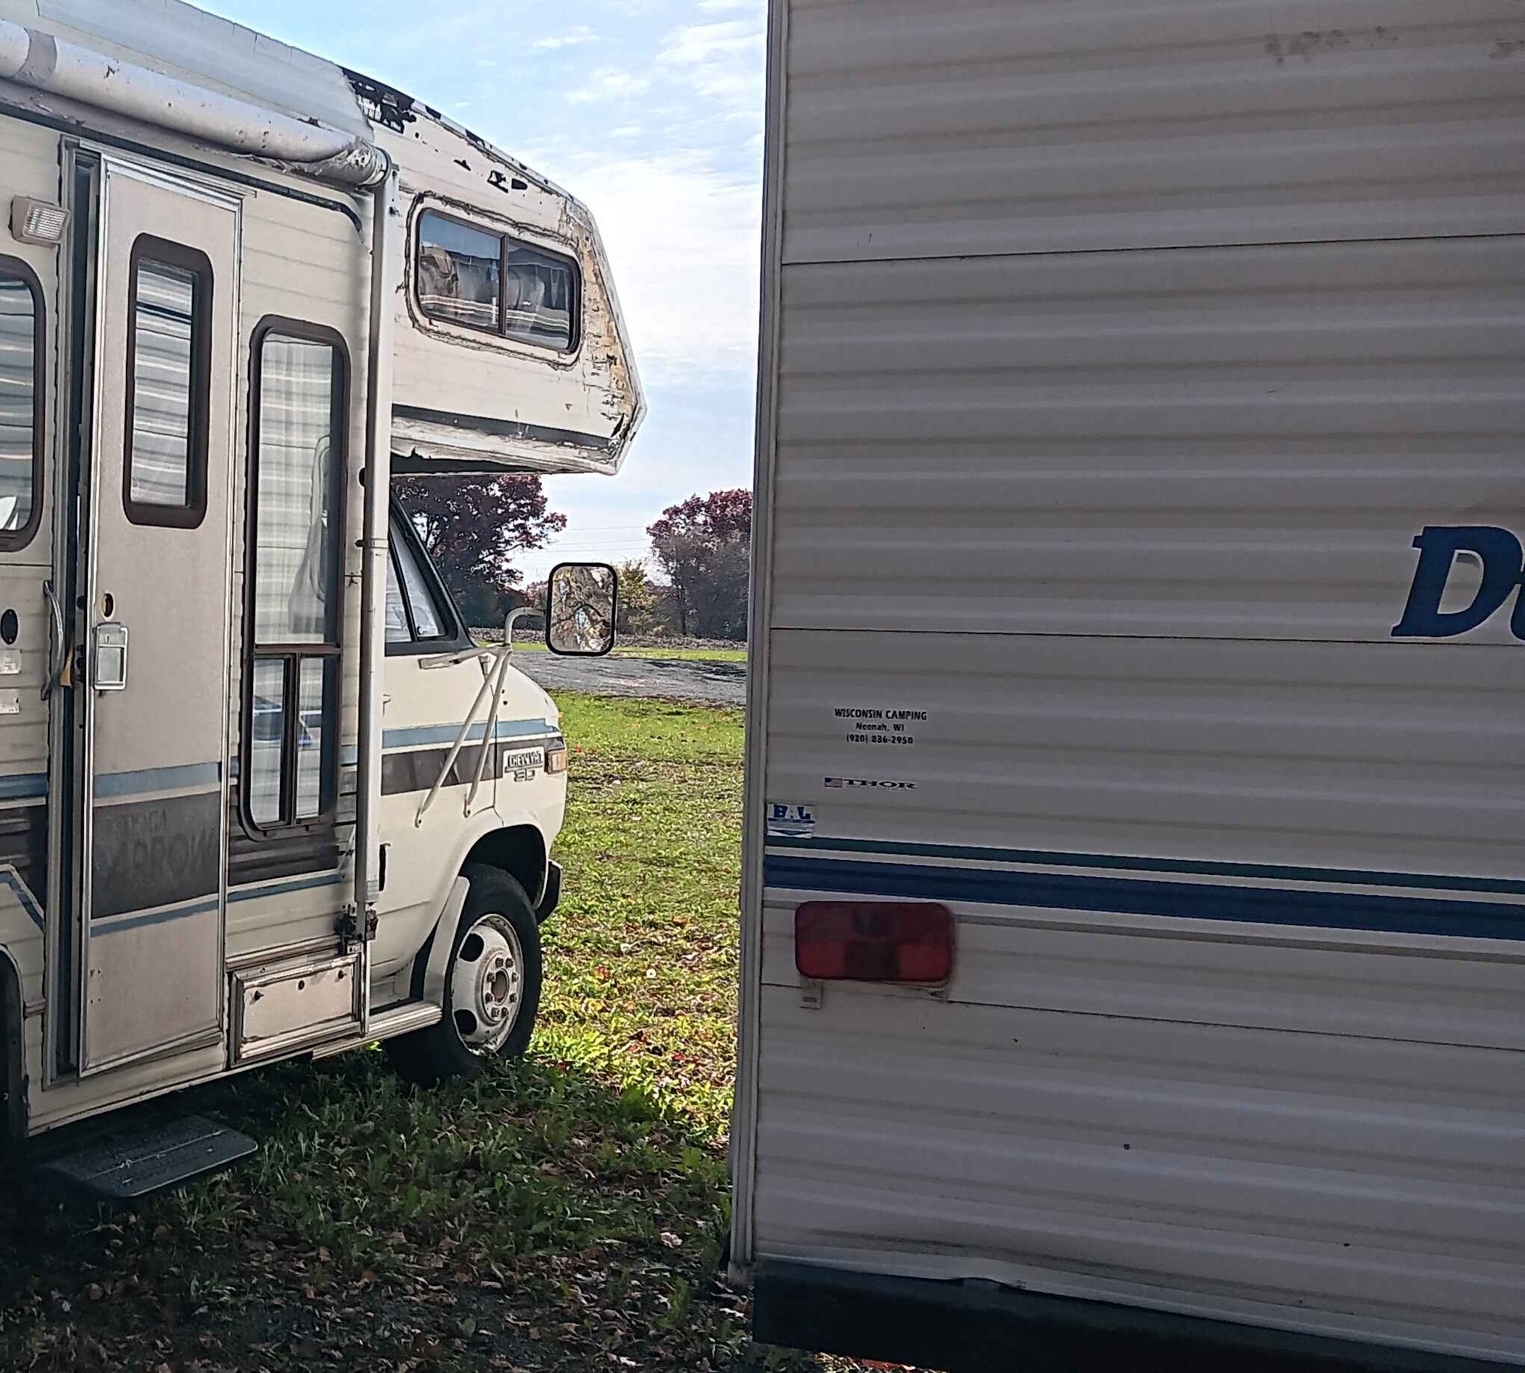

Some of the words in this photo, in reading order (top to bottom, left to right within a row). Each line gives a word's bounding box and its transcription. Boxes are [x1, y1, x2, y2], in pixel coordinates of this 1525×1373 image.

[1390, 525, 1525, 641] D
[834, 708, 882, 718] WISCONSIN
[885, 710, 927, 720] CAMPING
[855, 722, 890, 732] Neenah,
[893, 723, 904, 731] WI
[846, 733, 869, 743] (920)
[843, 779, 916, 789] THOR
